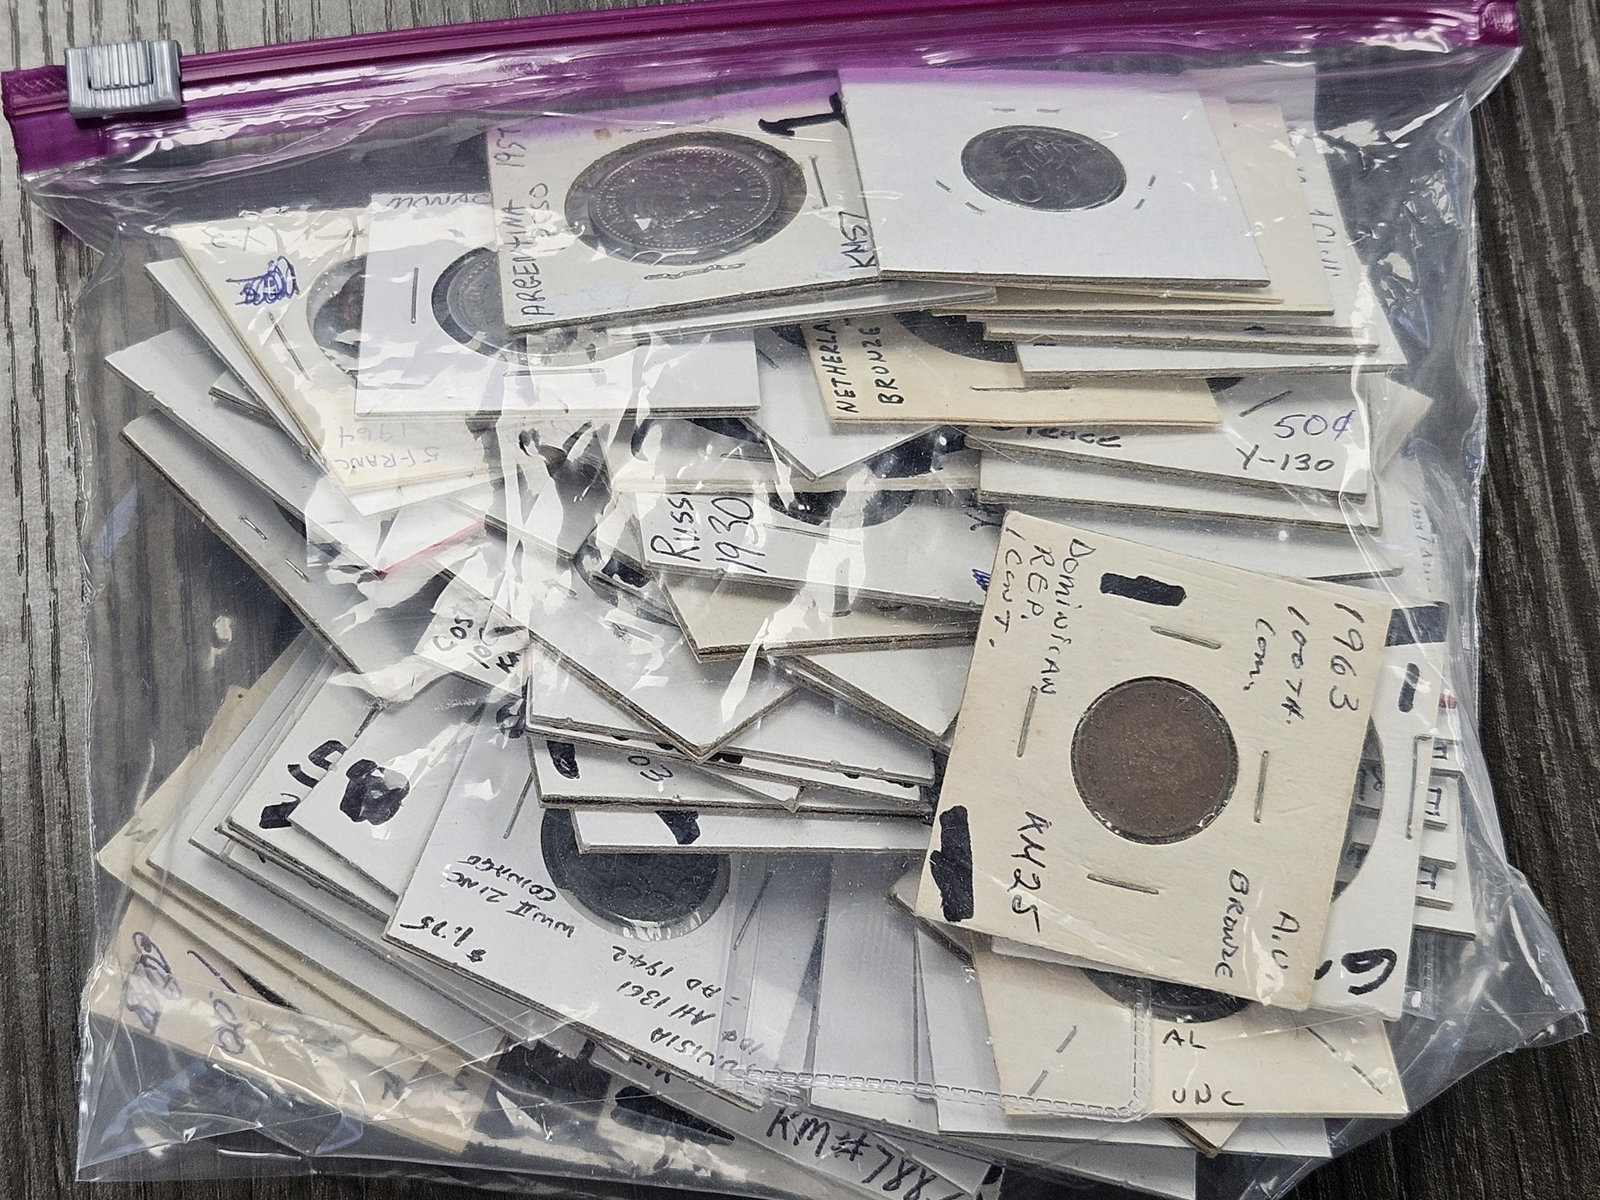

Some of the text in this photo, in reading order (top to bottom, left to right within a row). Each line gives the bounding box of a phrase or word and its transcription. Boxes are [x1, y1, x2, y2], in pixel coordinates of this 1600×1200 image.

[812, 319, 859, 414] NETHERLA
[858, 325, 905, 405] BRONZE
[1026, 426, 1122, 449] ence
[1273, 409, 1357, 441] 50¢
[1236, 444, 1335, 472] Y-130
[707, 496, 769, 574] 1930
[1327, 601, 1367, 712] 1963
[611, 945, 674, 978] 1942
[615, 980, 668, 1011] 1361
[1162, 1028, 1206, 1050] AL
[766, 1106, 962, 1200] KM#788
